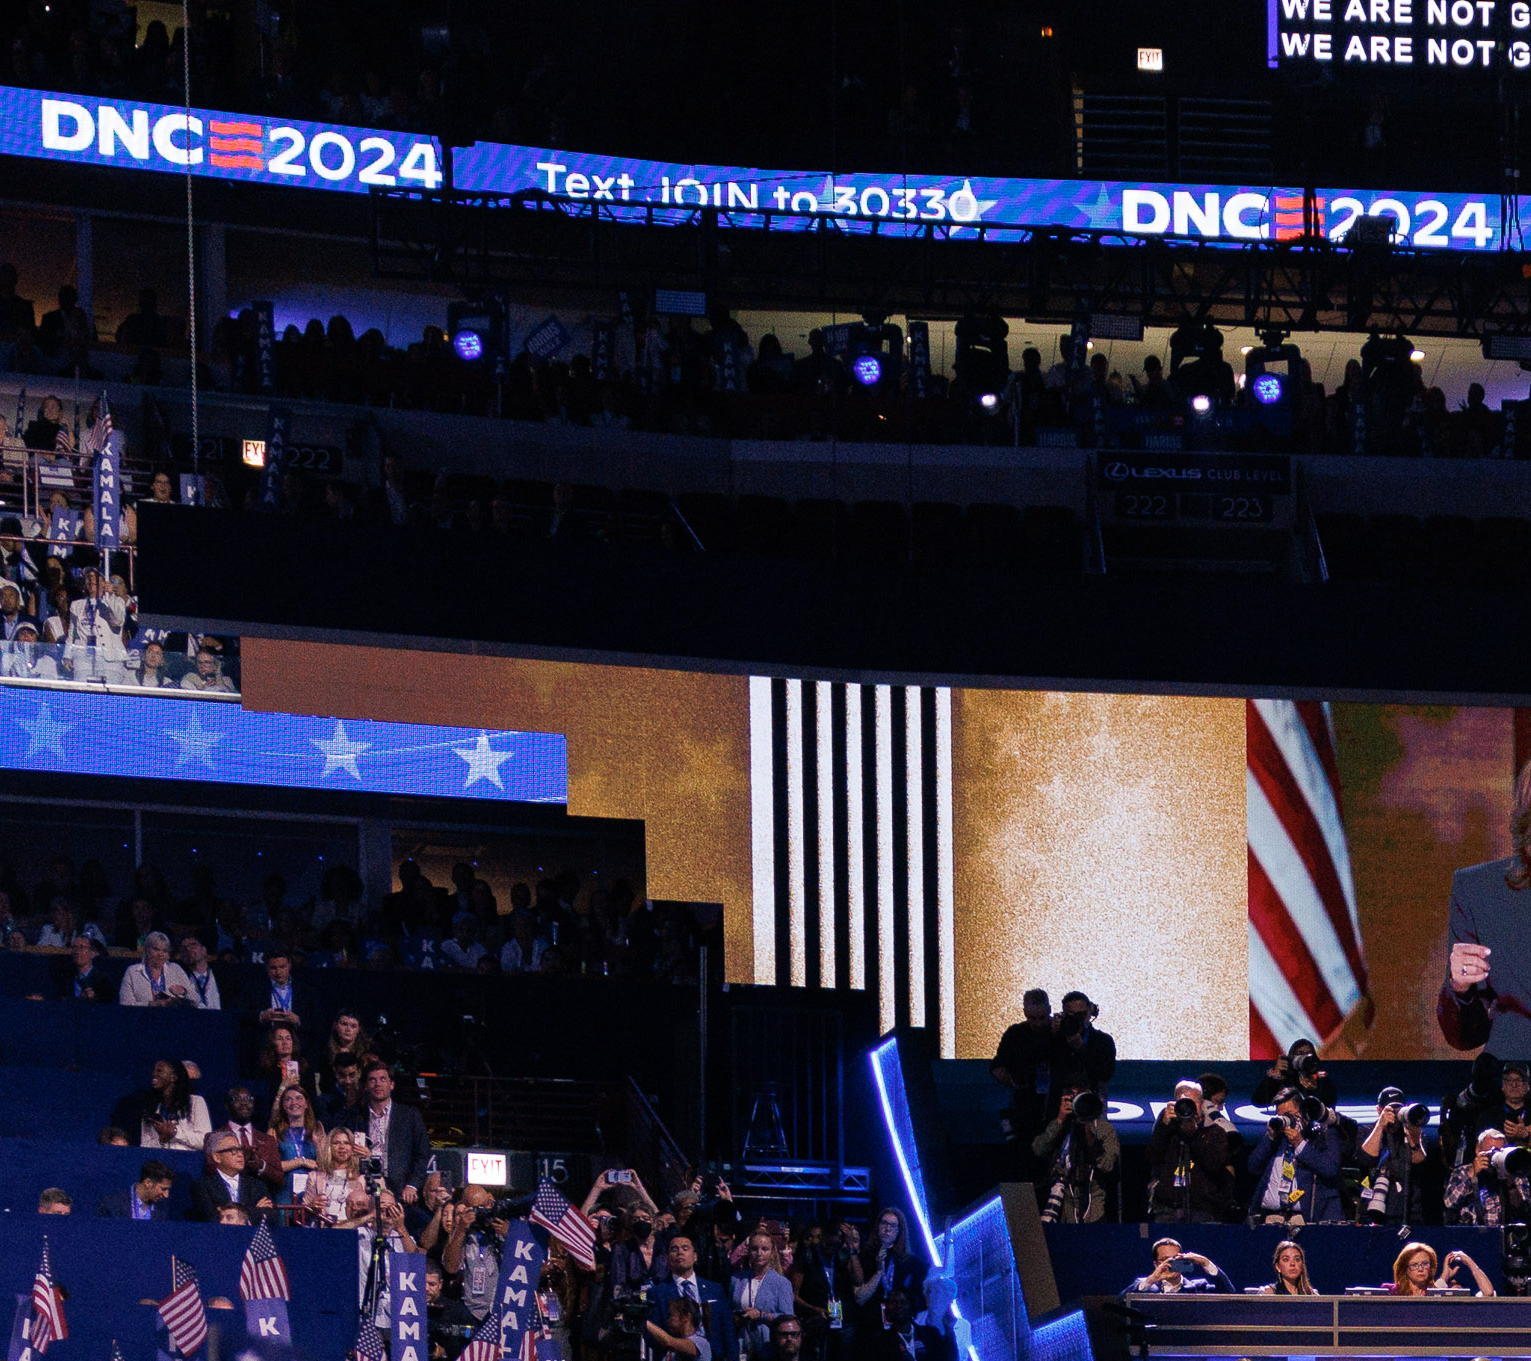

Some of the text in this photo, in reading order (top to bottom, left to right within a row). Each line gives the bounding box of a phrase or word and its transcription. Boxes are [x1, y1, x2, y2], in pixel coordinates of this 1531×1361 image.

[1284, 0, 1332, 21] WE
[1344, 0, 1413, 24] ARE
[1428, 0, 1496, 28] NOT
[1282, 32, 1332, 61] WE
[1344, 35, 1413, 64] ARE
[1428, 38, 1496, 67] NOT
[41, 98, 444, 189] DNC 2024
[536, 162, 979, 222] Text JOIN to 30330
[1121, 189, 1271, 240] DNC
[596, 331, 608, 381] KAMA
[722, 341, 737, 391] KAMA
[243, 439, 266, 463] EXI
[285, 446, 331, 471] 222
[100, 442, 116, 538] KAMALA
[1129, 467, 1203, 482] LEXUS
[1206, 467, 1244, 482] CLUB
[1124, 495, 1168, 517] 222
[1221, 496, 1264, 519] 223
[53, 517, 71, 558] KAM
[471, 1158, 503, 1176] EXIT
[543, 1158, 569, 1184] 15
[501, 1239, 535, 1353] KAMAL
